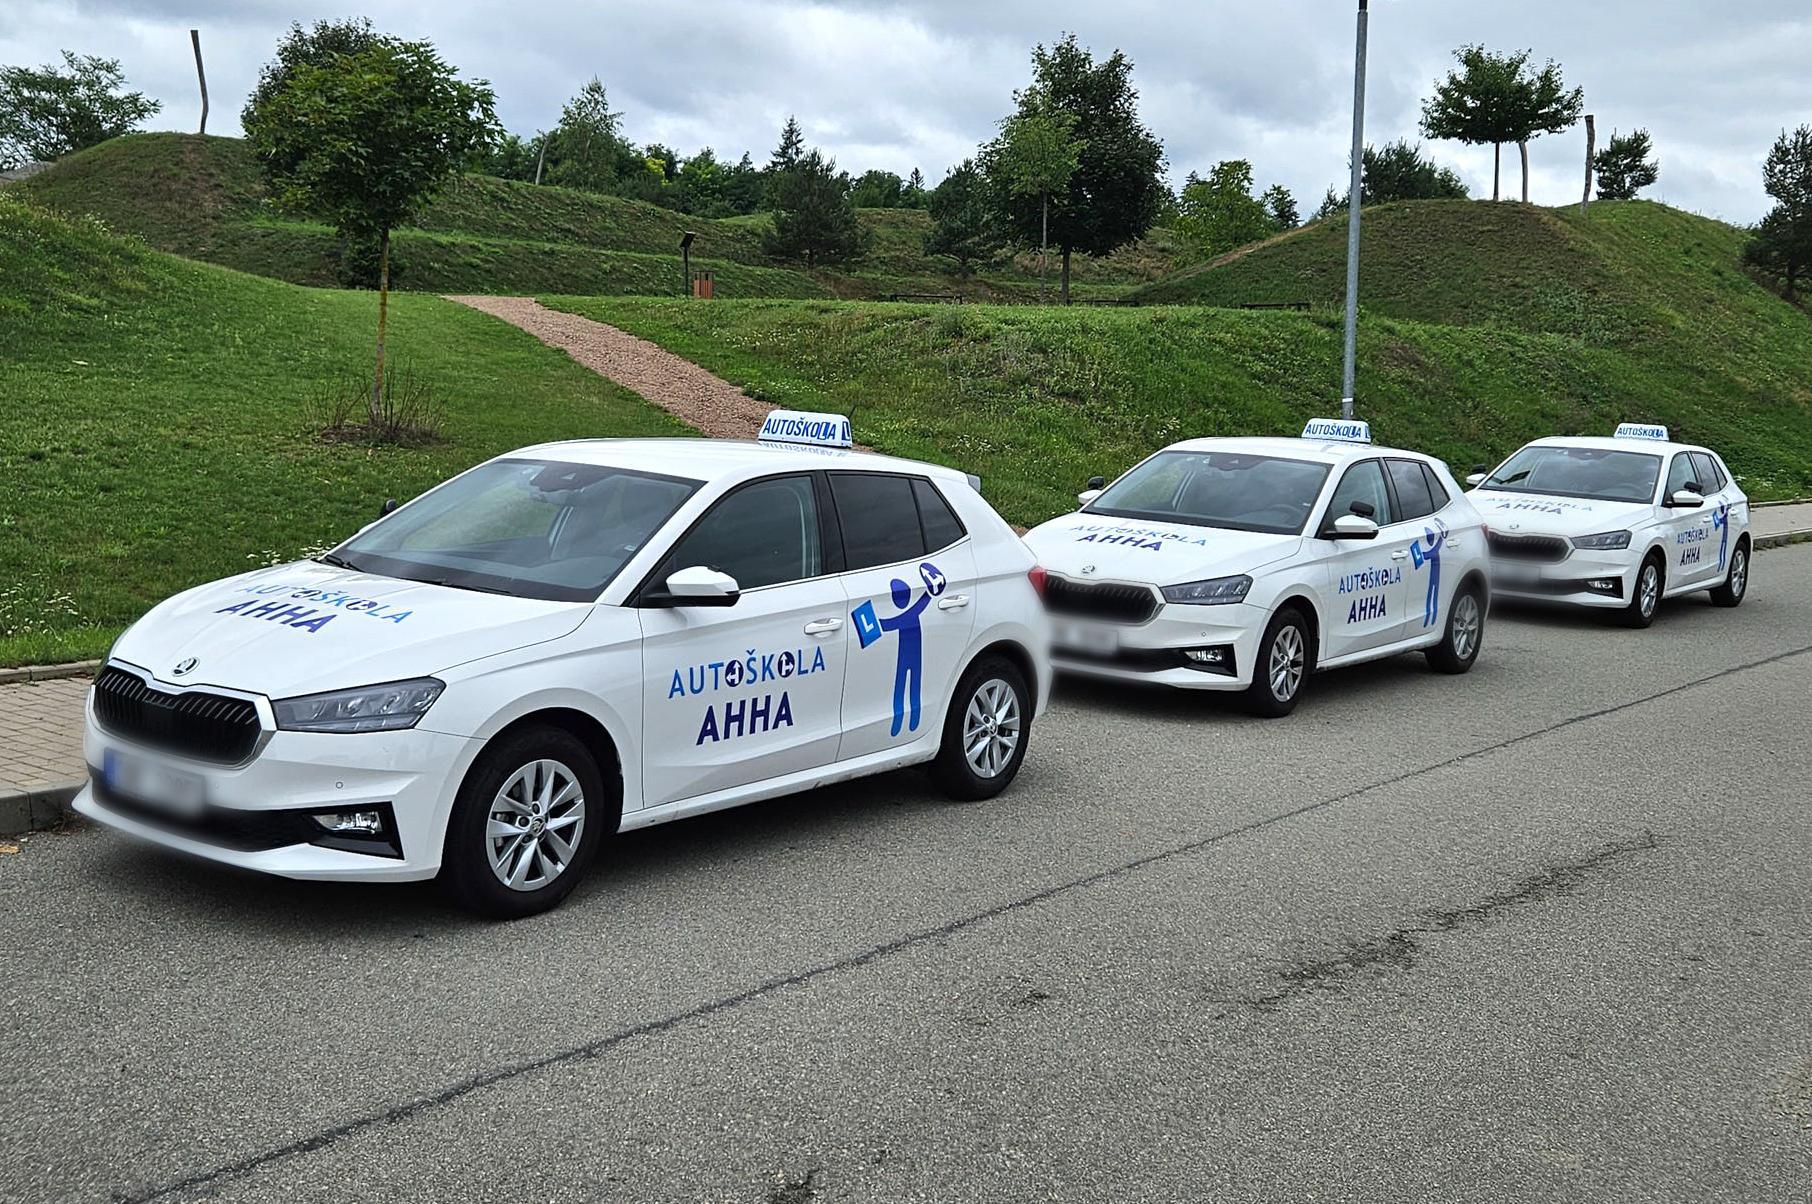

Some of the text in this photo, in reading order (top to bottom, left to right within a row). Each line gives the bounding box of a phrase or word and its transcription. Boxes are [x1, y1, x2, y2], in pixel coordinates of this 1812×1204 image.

[762, 416, 837, 440] AUTOŠKOLA
[1305, 423, 1361, 438] AUTOŠKOLA
[1076, 533, 1163, 551] AHHA
[1338, 567, 1401, 594] AUTOŠKOLA
[214, 599, 338, 633] AHHA
[1347, 594, 1386, 624] AHHA
[668, 648, 826, 699] AUTOŠKOLA
[696, 691, 794, 746] AHHA
